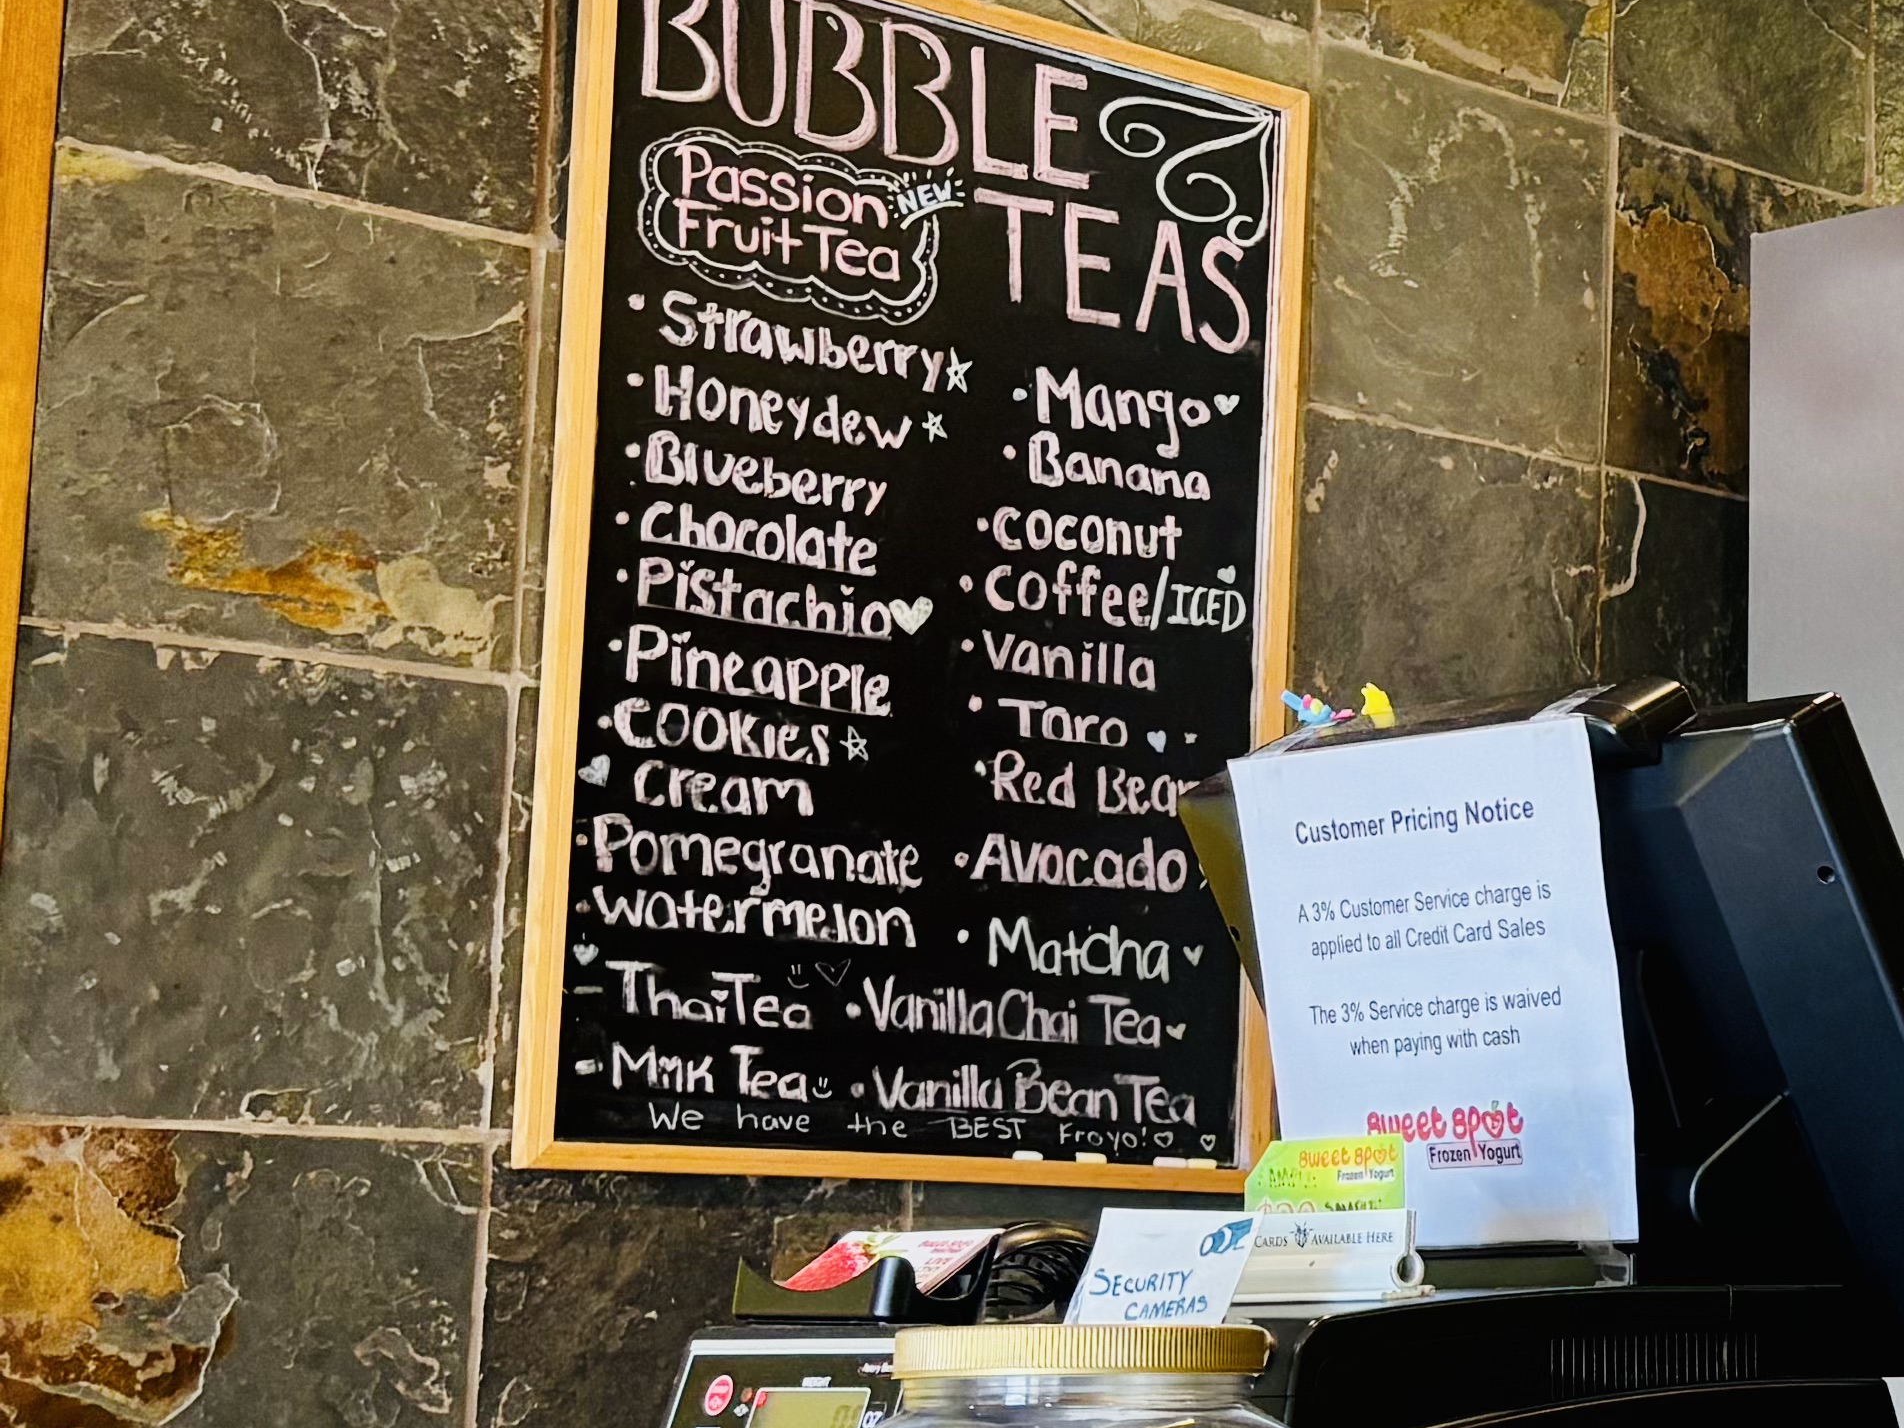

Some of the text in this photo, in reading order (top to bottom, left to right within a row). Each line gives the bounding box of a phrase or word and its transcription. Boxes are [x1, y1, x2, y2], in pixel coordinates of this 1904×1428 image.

[674, 145, 888, 228] Passion
[897, 181, 953, 216] NEW
[673, 198, 900, 281] Fruit Tea
[974, 188, 1250, 353] TEAS
[659, 290, 944, 392] Strawberry
[654, 364, 912, 449] Honeydew
[1035, 366, 1211, 459] Mango
[645, 430, 887, 515] Blueberry
[1028, 430, 1211, 501] Banana
[641, 501, 878, 576] Chocolate
[637, 557, 892, 641] Pistachio
[625, 624, 891, 717] Pineapple
[982, 628, 1157, 692] Vanilla
[633, 759, 814, 816] Cream
[991, 749, 1076, 809] Red
[593, 813, 922, 896] Pomegranate
[1295, 797, 1535, 846] Customer Pricing Notice
[970, 833, 1188, 893] Avocado
[1298, 879, 1552, 924] A 3% Customer Service charge is
[988, 915, 1170, 984] Matcha
[1311, 917, 1546, 960] applied to all Credit Card Sales
[605, 960, 813, 1030] Thai Tea
[863, 975, 1161, 1048] Vanilla Chai Tea
[1309, 985, 1562, 1025] The 3% Service charge is waived
[1350, 1024, 1521, 1057] when paying with cash
[730, 1045, 808, 1103] Tea
[872, 1058, 1197, 1127] Vanilla Bean Tea
[649, 1102, 1147, 1156] We have the BEST Froyo!
[1429, 1143, 1521, 1165] Frozen Yogurt
[1311, 1232, 1362, 1245] AVAILABLE
[1366, 1231, 1393, 1243] HERE
[1089, 1268, 1194, 1296] SECURITY
[1124, 1295, 1208, 1321] CAMERAS
